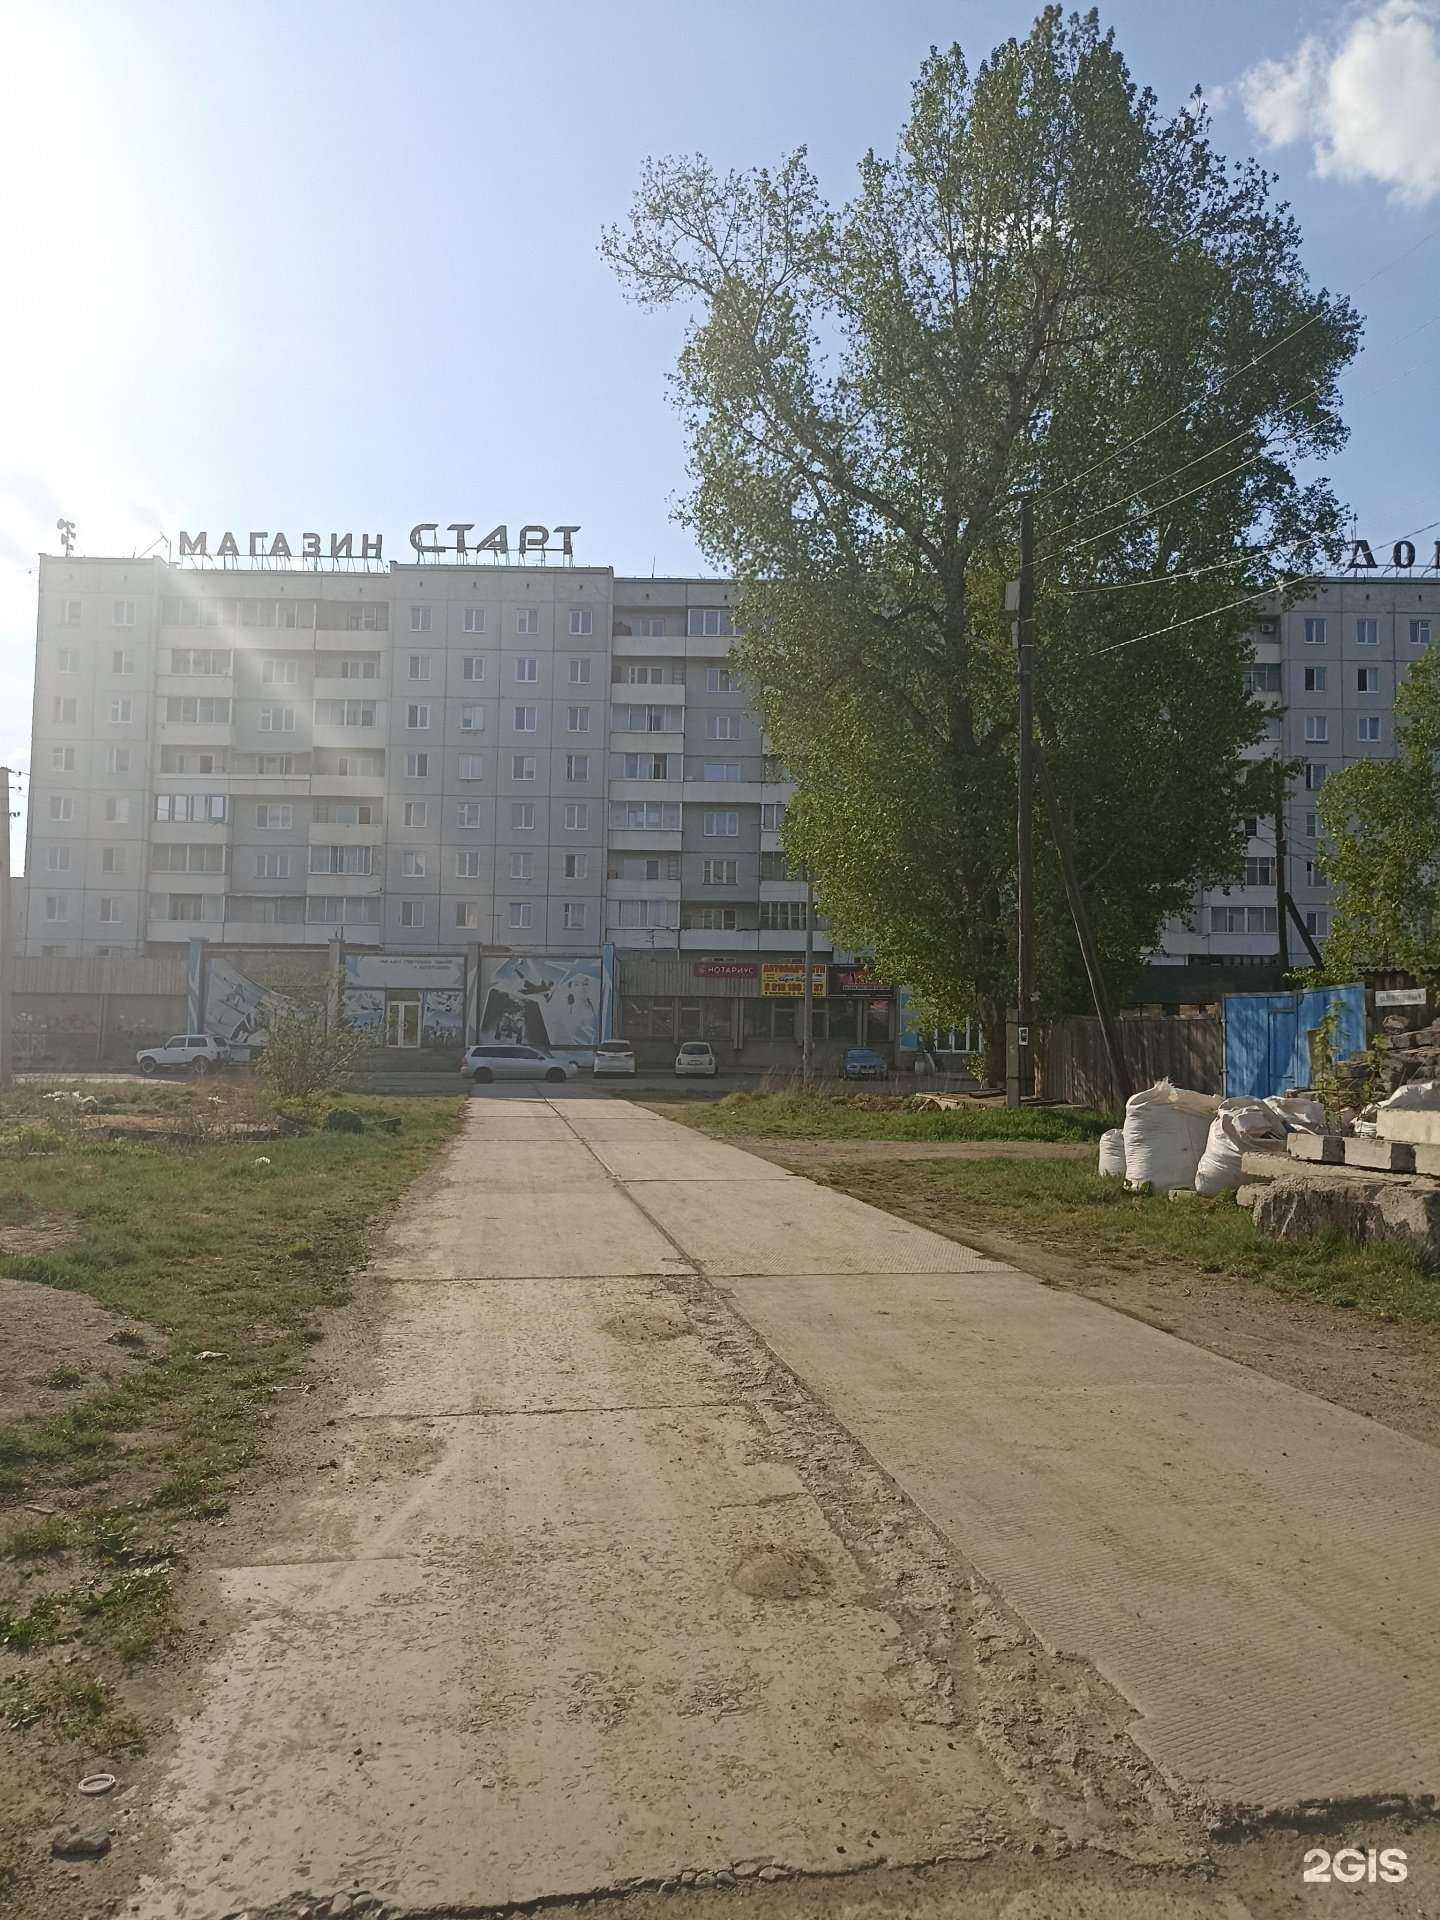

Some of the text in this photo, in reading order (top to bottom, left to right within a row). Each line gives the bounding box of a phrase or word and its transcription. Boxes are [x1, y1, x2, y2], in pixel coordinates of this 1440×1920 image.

[179, 524, 581, 557] МАГАЗИН СТАРТ
[708, 966, 754, 974] НОТАРИУС
